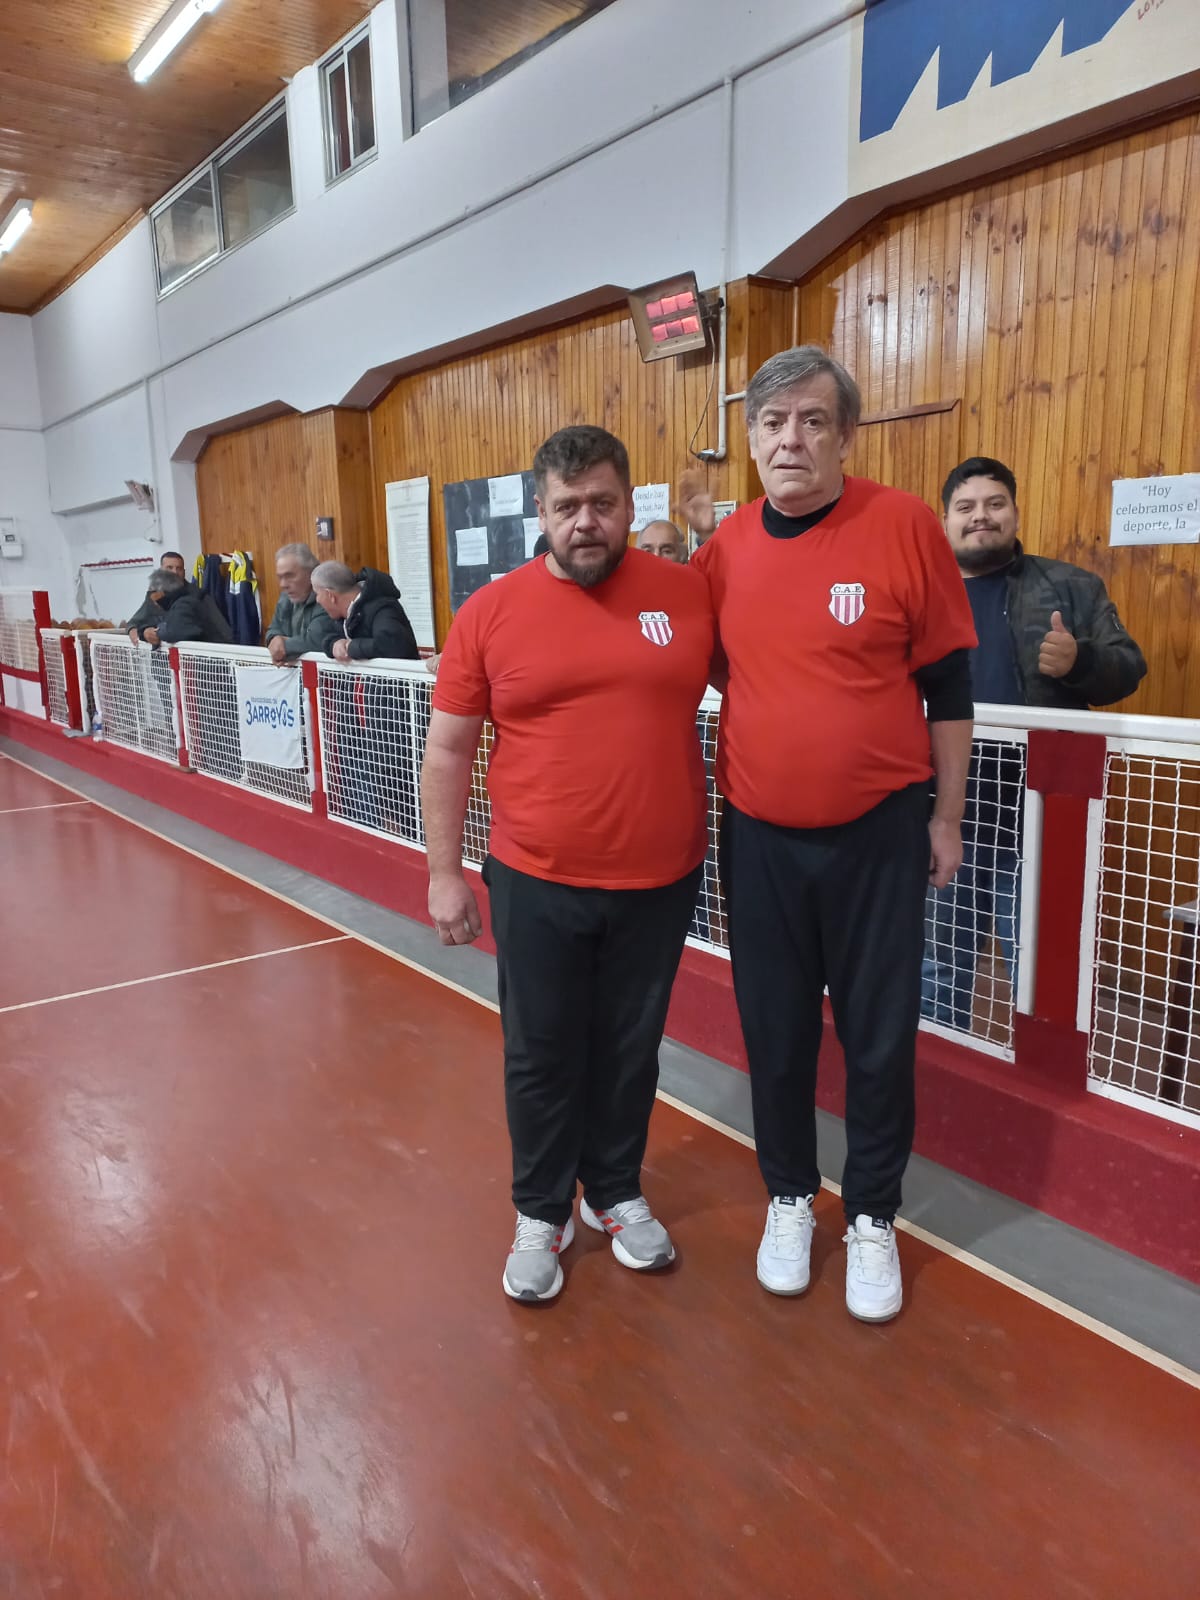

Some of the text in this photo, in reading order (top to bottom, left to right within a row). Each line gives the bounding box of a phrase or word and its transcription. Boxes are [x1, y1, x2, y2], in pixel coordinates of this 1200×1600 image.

[1115, 498, 1198, 516] celebramos el
[1123, 518, 1186, 534] deporte, la
